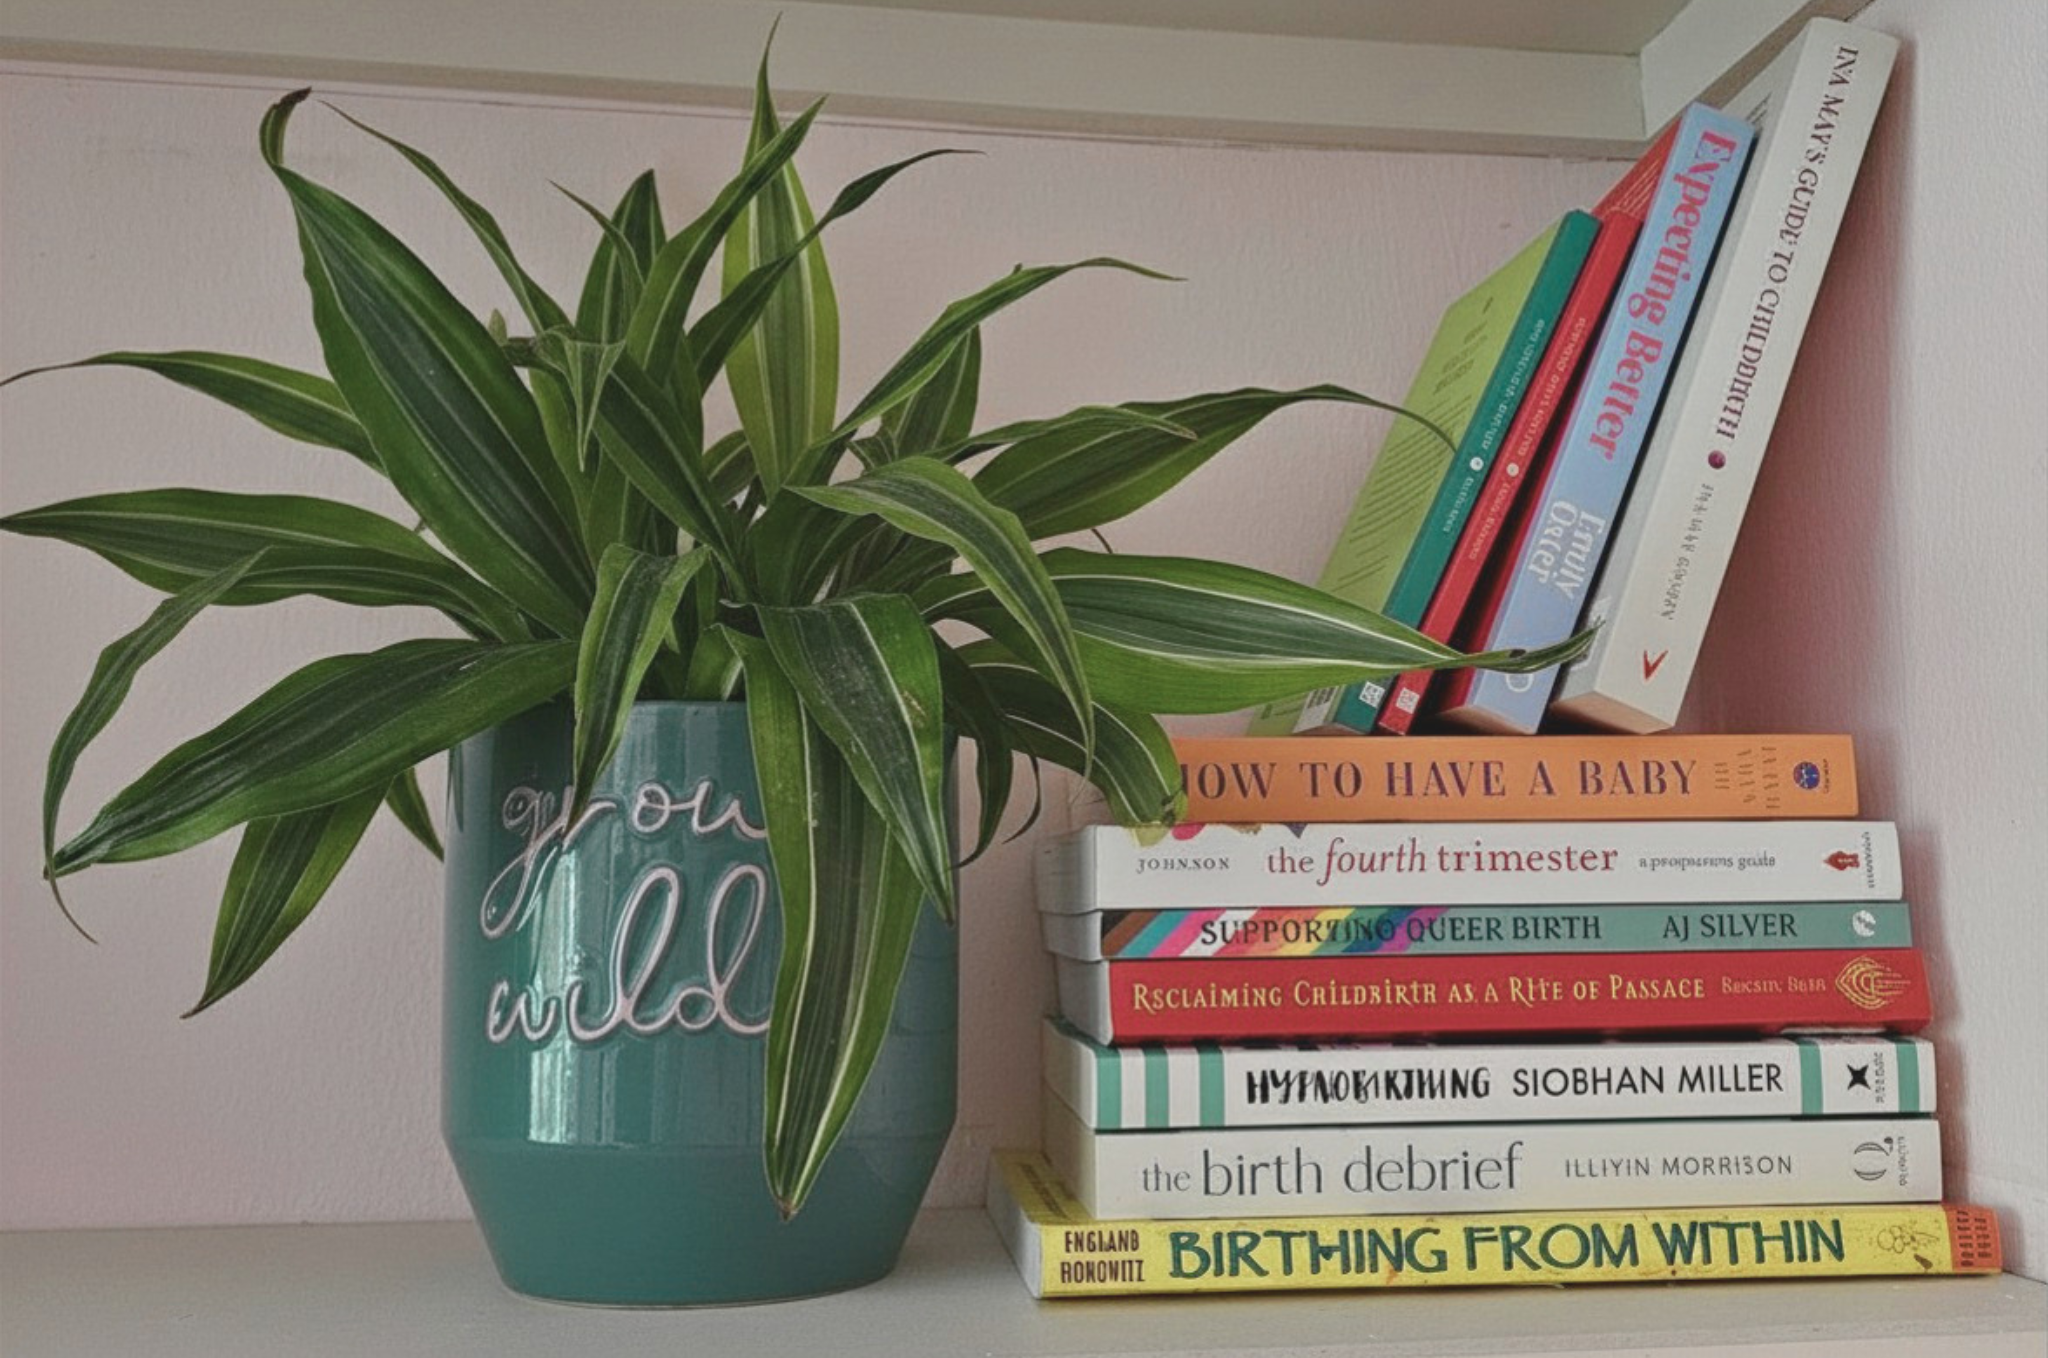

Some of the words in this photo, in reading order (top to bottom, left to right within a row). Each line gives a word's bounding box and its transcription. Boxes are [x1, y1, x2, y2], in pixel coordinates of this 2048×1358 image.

[1628, 130, 1737, 325] Expecting
[1768, 251, 1794, 283] TO
[1590, 330, 1664, 461] Better
[1180, 761, 1277, 798] OW
[1300, 761, 1363, 798] TO
[1386, 760, 1506, 797] HAVE
[1529, 760, 1556, 796] A
[1578, 759, 1697, 795] BABY
[1136, 857, 1230, 874] JOHNSON
[1267, 847, 1314, 873] the
[1315, 838, 1427, 886] fourth
[1437, 841, 1618, 873] trimester
[487, 864, 770, 1041] wild
[1408, 916, 1502, 945] QUEER
[1512, 914, 1602, 940] BIRTH
[1663, 914, 1690, 942] AJ
[1701, 912, 1798, 938] SILVER
[1512, 1065, 1664, 1096] SIOBHAN
[1678, 1063, 1783, 1093] MILLER
[1142, 1162, 1191, 1192] the
[1203, 1146, 1323, 1196] birth
[1343, 1141, 1523, 1193] debrief
[1566, 1156, 1650, 1178] ILLIYIN
[1662, 1155, 1793, 1176] MORRISON
[1169, 1226, 1447, 1279] BIRTHING
[1463, 1222, 1638, 1271] FROM
[1653, 1218, 1846, 1267] WITHIN
